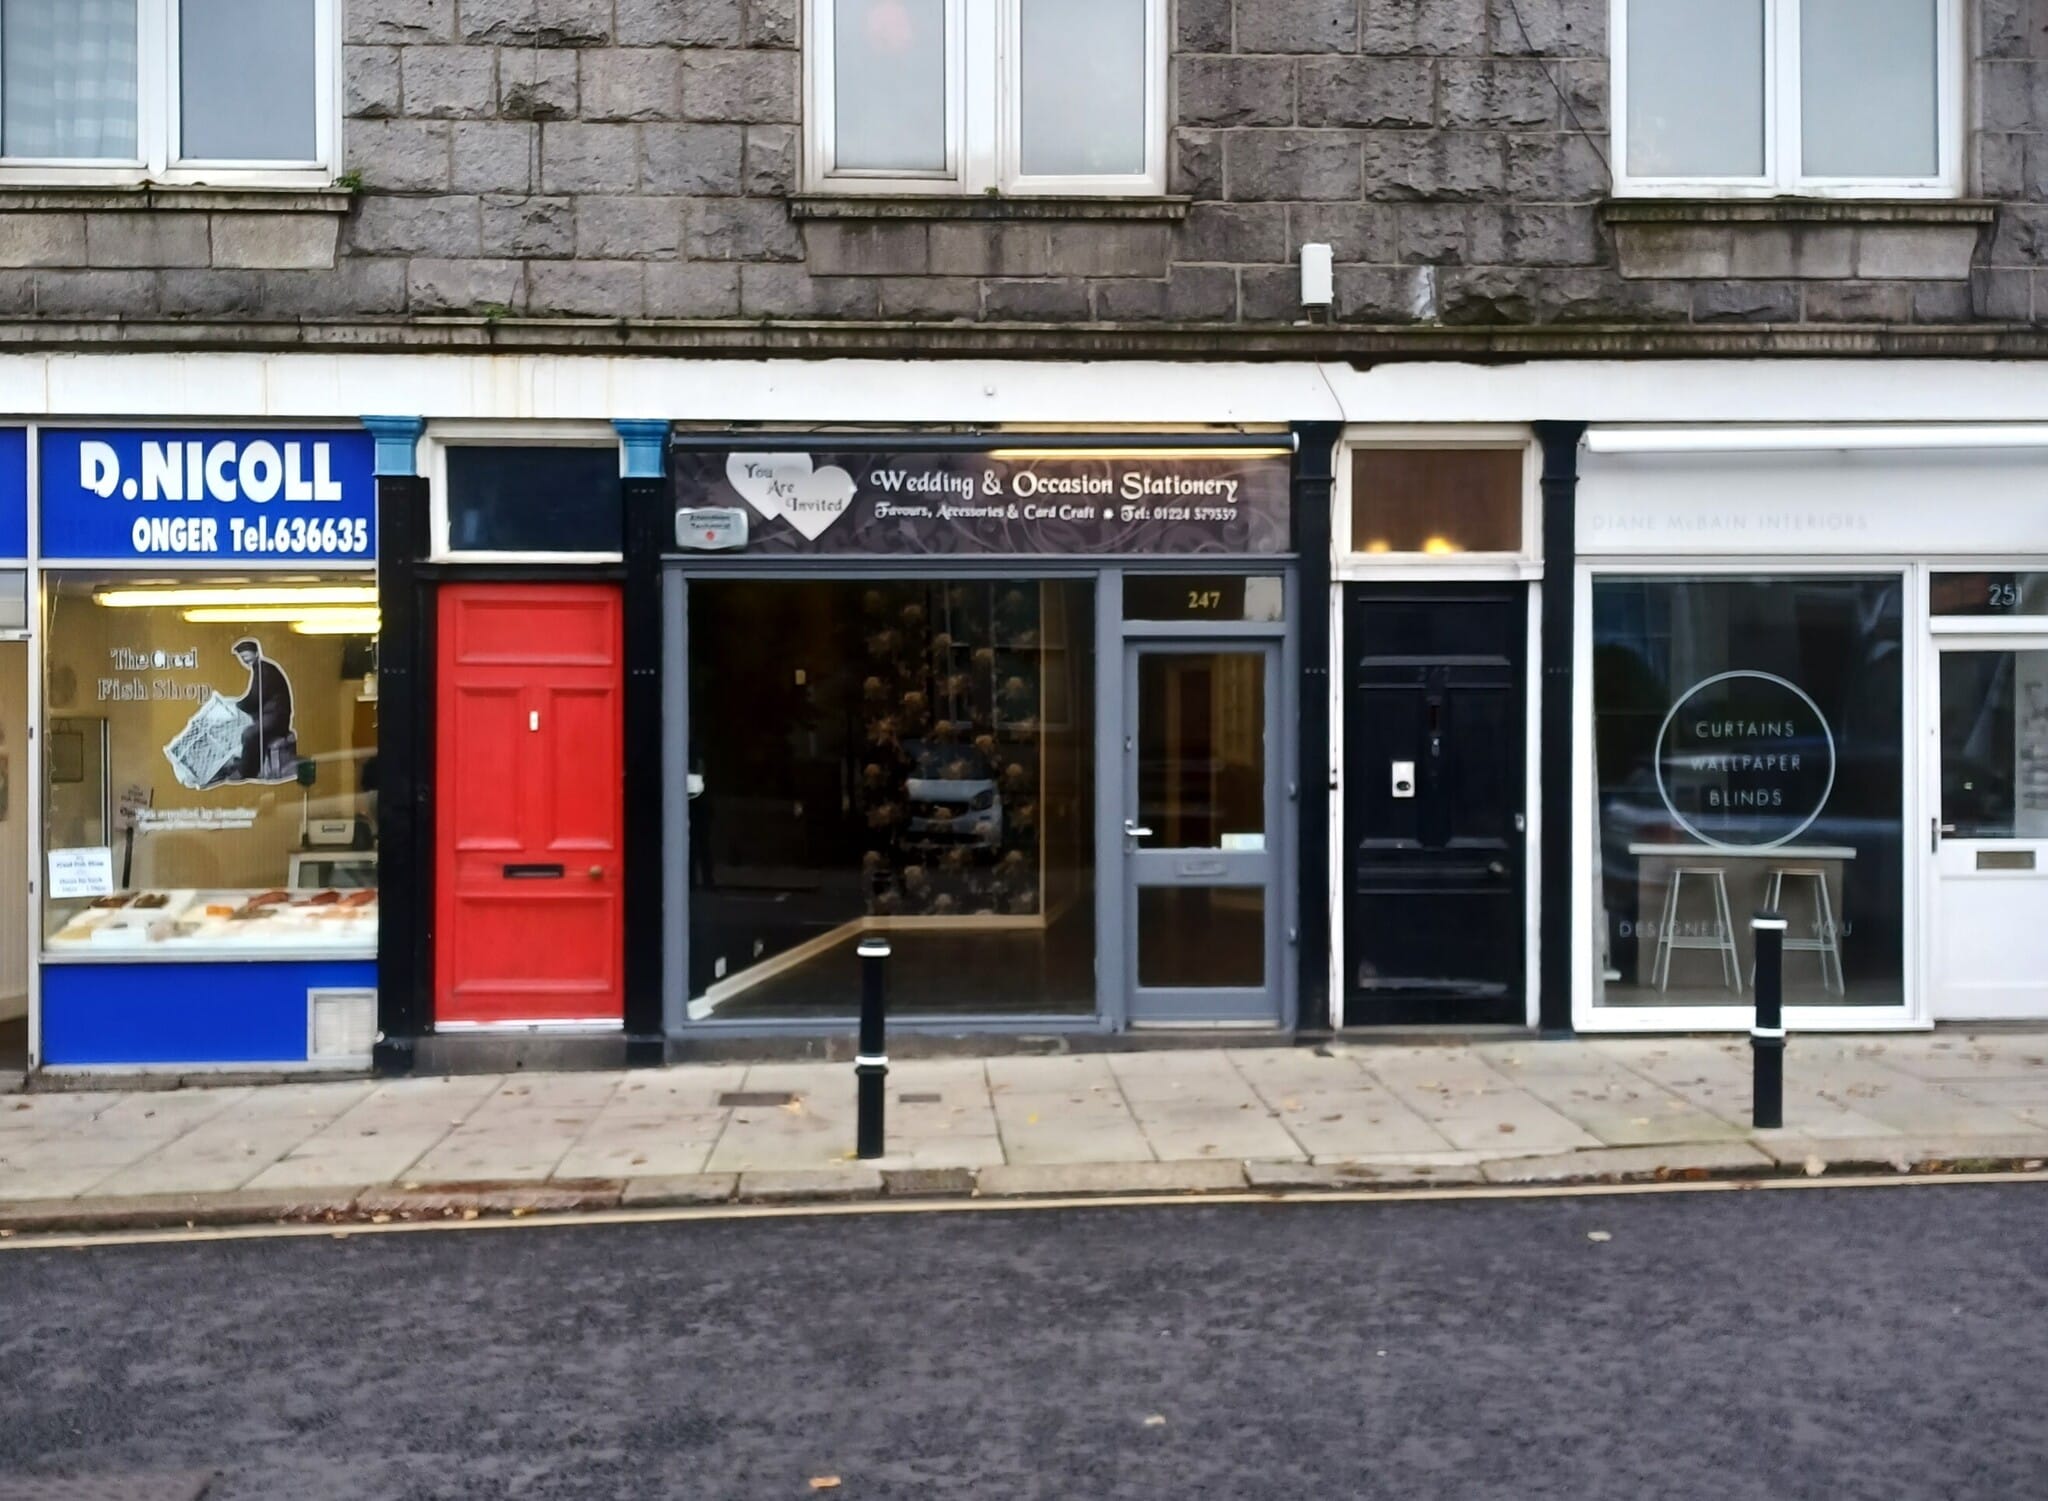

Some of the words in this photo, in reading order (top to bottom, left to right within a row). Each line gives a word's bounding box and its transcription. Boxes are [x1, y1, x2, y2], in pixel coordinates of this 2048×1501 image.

[80, 440, 342, 502] D.NICOLL
[745, 463, 773, 479] You
[766, 480, 795, 497] Are
[870, 470, 974, 500] Wedding
[982, 469, 1004, 495] &
[1012, 471, 1113, 497] Occasion
[1120, 472, 1238, 503] Stationery
[785, 497, 843, 512] Invited
[874, 501, 932, 519] Favours,
[936, 503, 1004, 520] Accessories
[1007, 503, 1019, 519] &
[1023, 504, 1056, 520] Card
[1059, 504, 1095, 520] Craft
[1121, 505, 1150, 522] Tel:
[1154, 506, 1190, 520] 01224
[1592, 513, 1656, 531] DIANE
[1758, 512, 1868, 531] INTERIORS
[132, 517, 217, 551] ONGER
[230, 515, 368, 552] Tel.636635
[1188, 591, 1221, 609] 247
[1987, 583, 2023, 606] 251
[110, 647, 149, 670] The
[98, 677, 148, 700] Fish
[153, 678, 213, 704] Shop
[1695, 720, 1795, 738] CURTAINS
[1690, 754, 1801, 772] WALLPAPER
[1709, 788, 1782, 806] BLINDS
